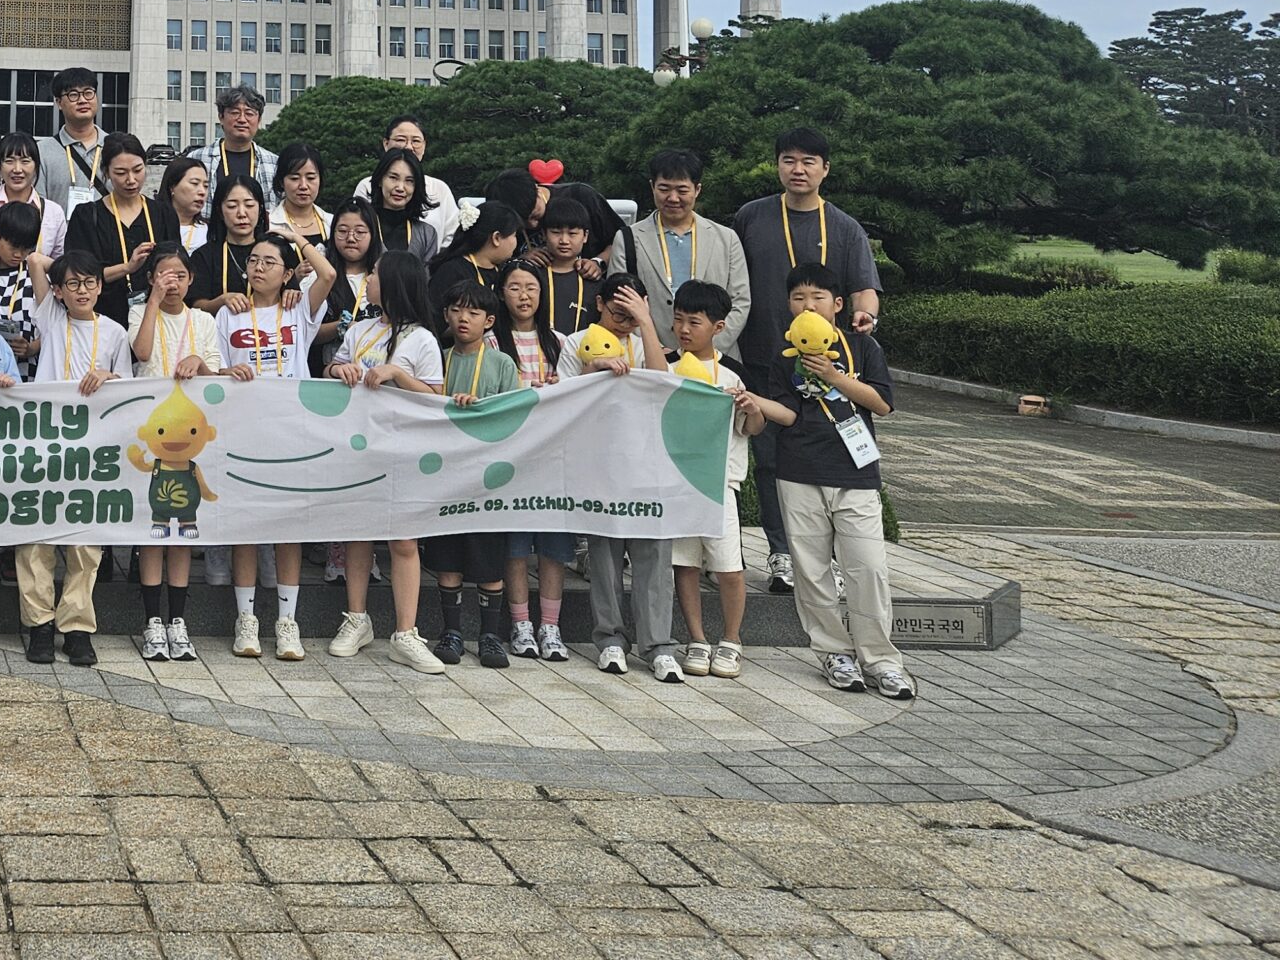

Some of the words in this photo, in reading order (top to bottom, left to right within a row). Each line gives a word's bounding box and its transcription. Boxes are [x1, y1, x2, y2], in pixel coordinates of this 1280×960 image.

[438, 501, 480, 517] 2025.
[484, 498, 509, 512] 09.
[937, 618, 964, 634] 국회
